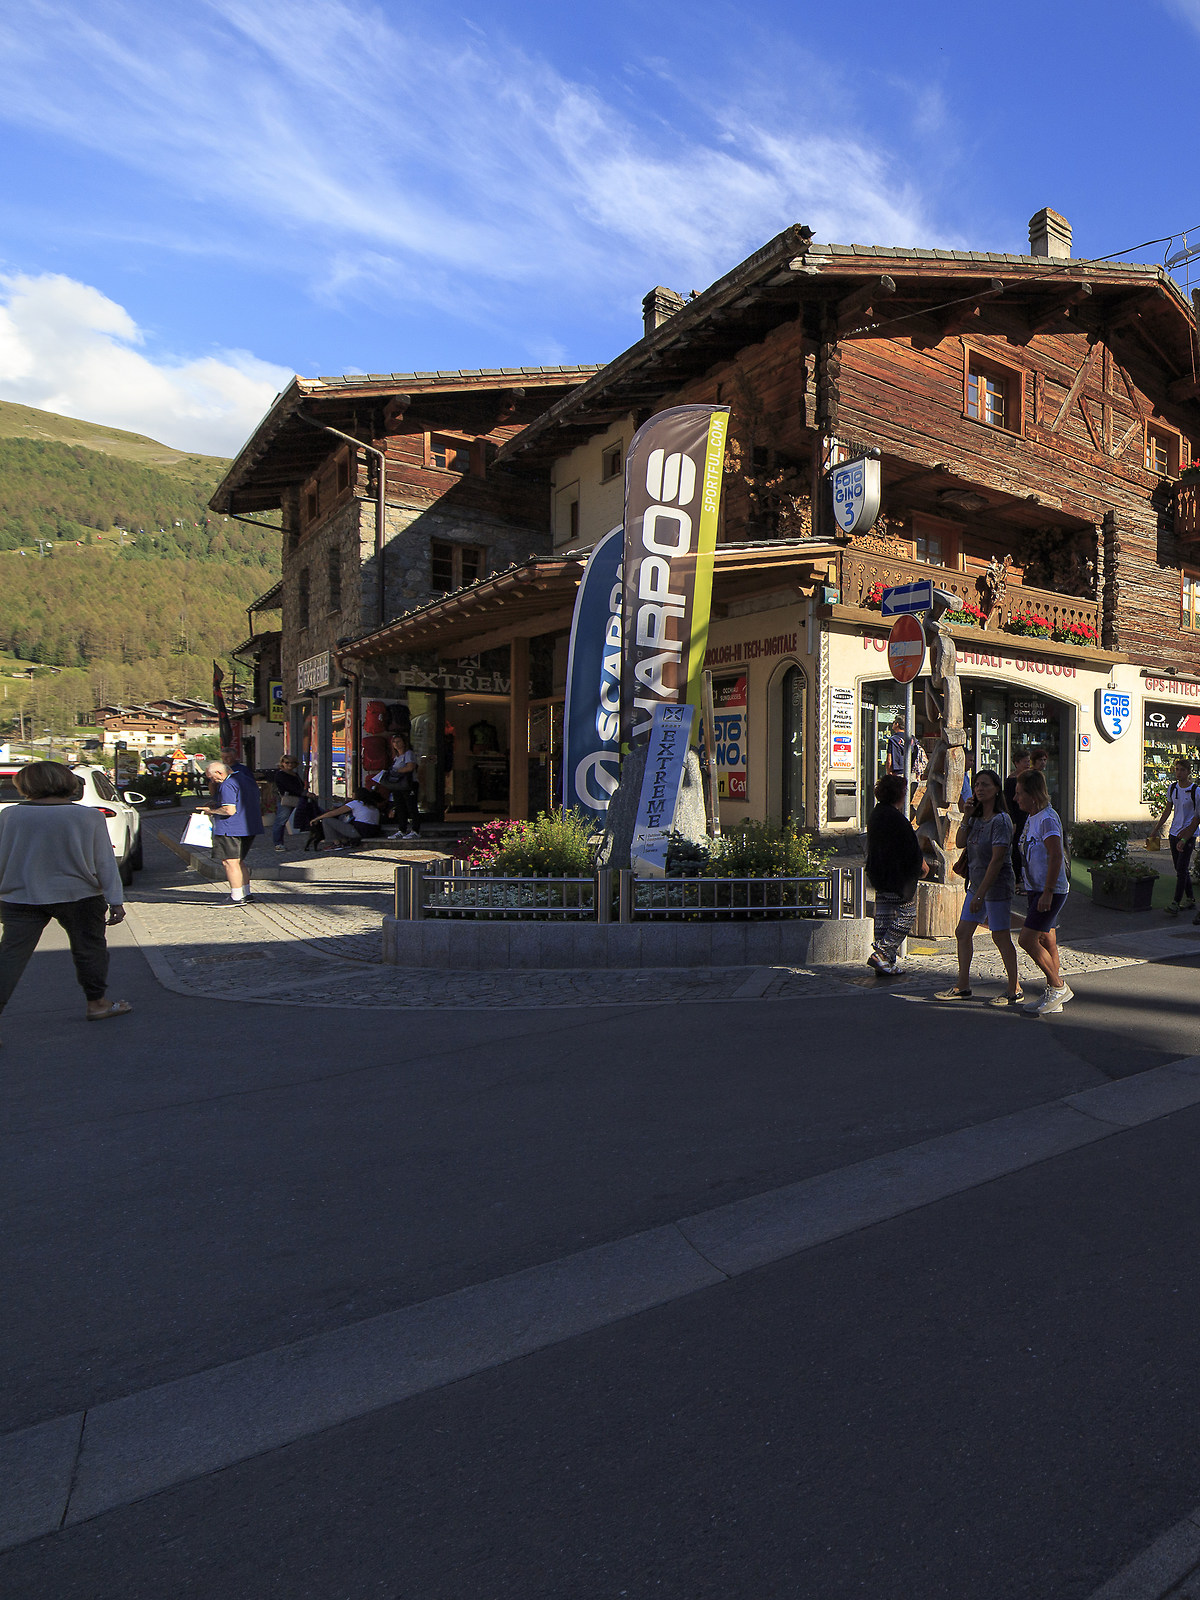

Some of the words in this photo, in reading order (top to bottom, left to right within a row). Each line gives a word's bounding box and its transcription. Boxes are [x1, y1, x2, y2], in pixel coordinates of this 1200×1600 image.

[704, 420, 724, 513] SPORTFUL.COM
[835, 464, 863, 489] FOTO
[835, 483, 863, 503] GINO
[844, 502, 854, 526] 3
[955, 650, 1003, 669] CHIALI
[1015, 657, 1077, 679] OROLOGI
[1013, 701, 1045, 709] OCCHIALI
[1103, 693, 1130, 707] FOTO
[1013, 716, 1048, 724] CELLULARI
[1103, 705, 1130, 717] GINO
[1112, 717, 1122, 735] 3
[1145, 720, 1170, 729] OAKLEY
[646, 730, 677, 829] EXTREME
